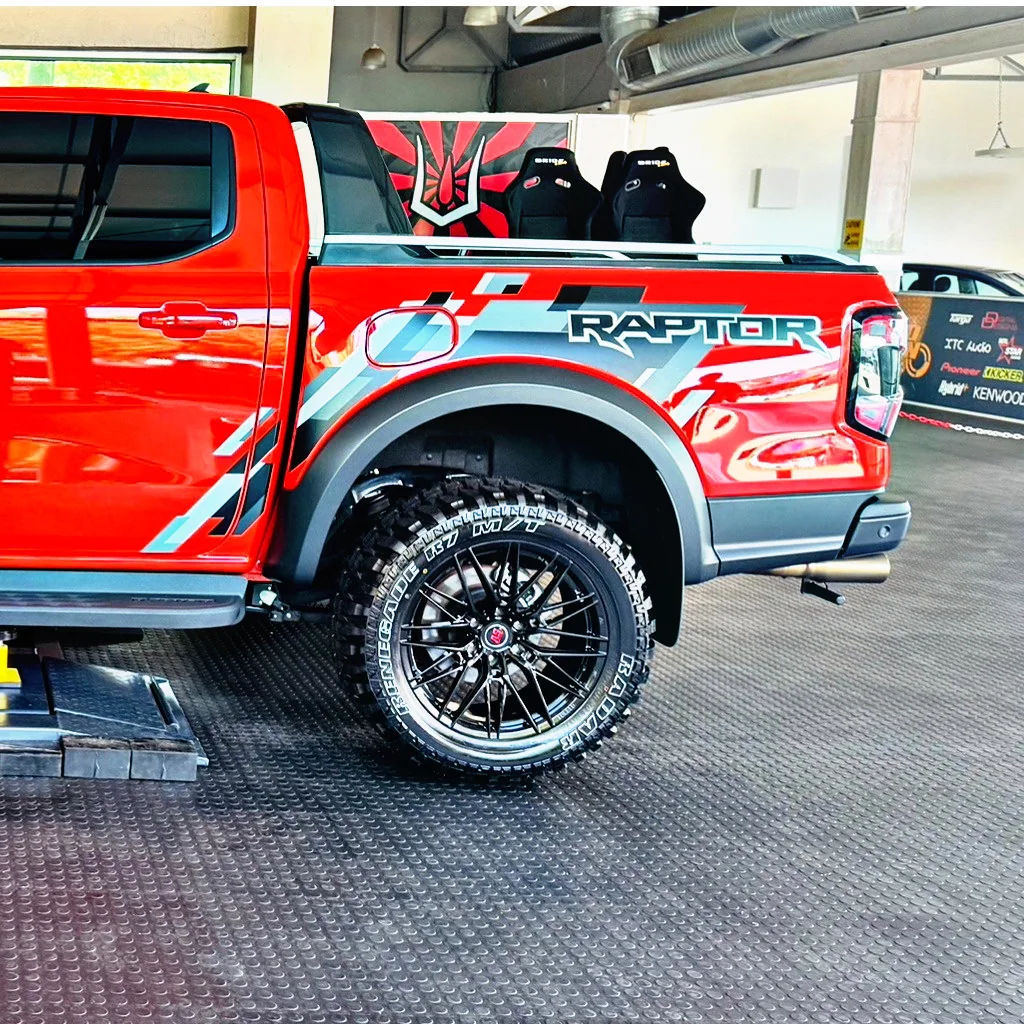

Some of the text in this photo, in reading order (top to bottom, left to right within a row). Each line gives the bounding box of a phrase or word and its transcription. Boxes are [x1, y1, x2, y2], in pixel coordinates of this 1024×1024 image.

[567, 309, 832, 359] RAPTOR
[940, 362, 982, 376] Pioneer
[376, 517, 547, 716] RENEGADE R7 M/T
[559, 651, 636, 751] RADAR
